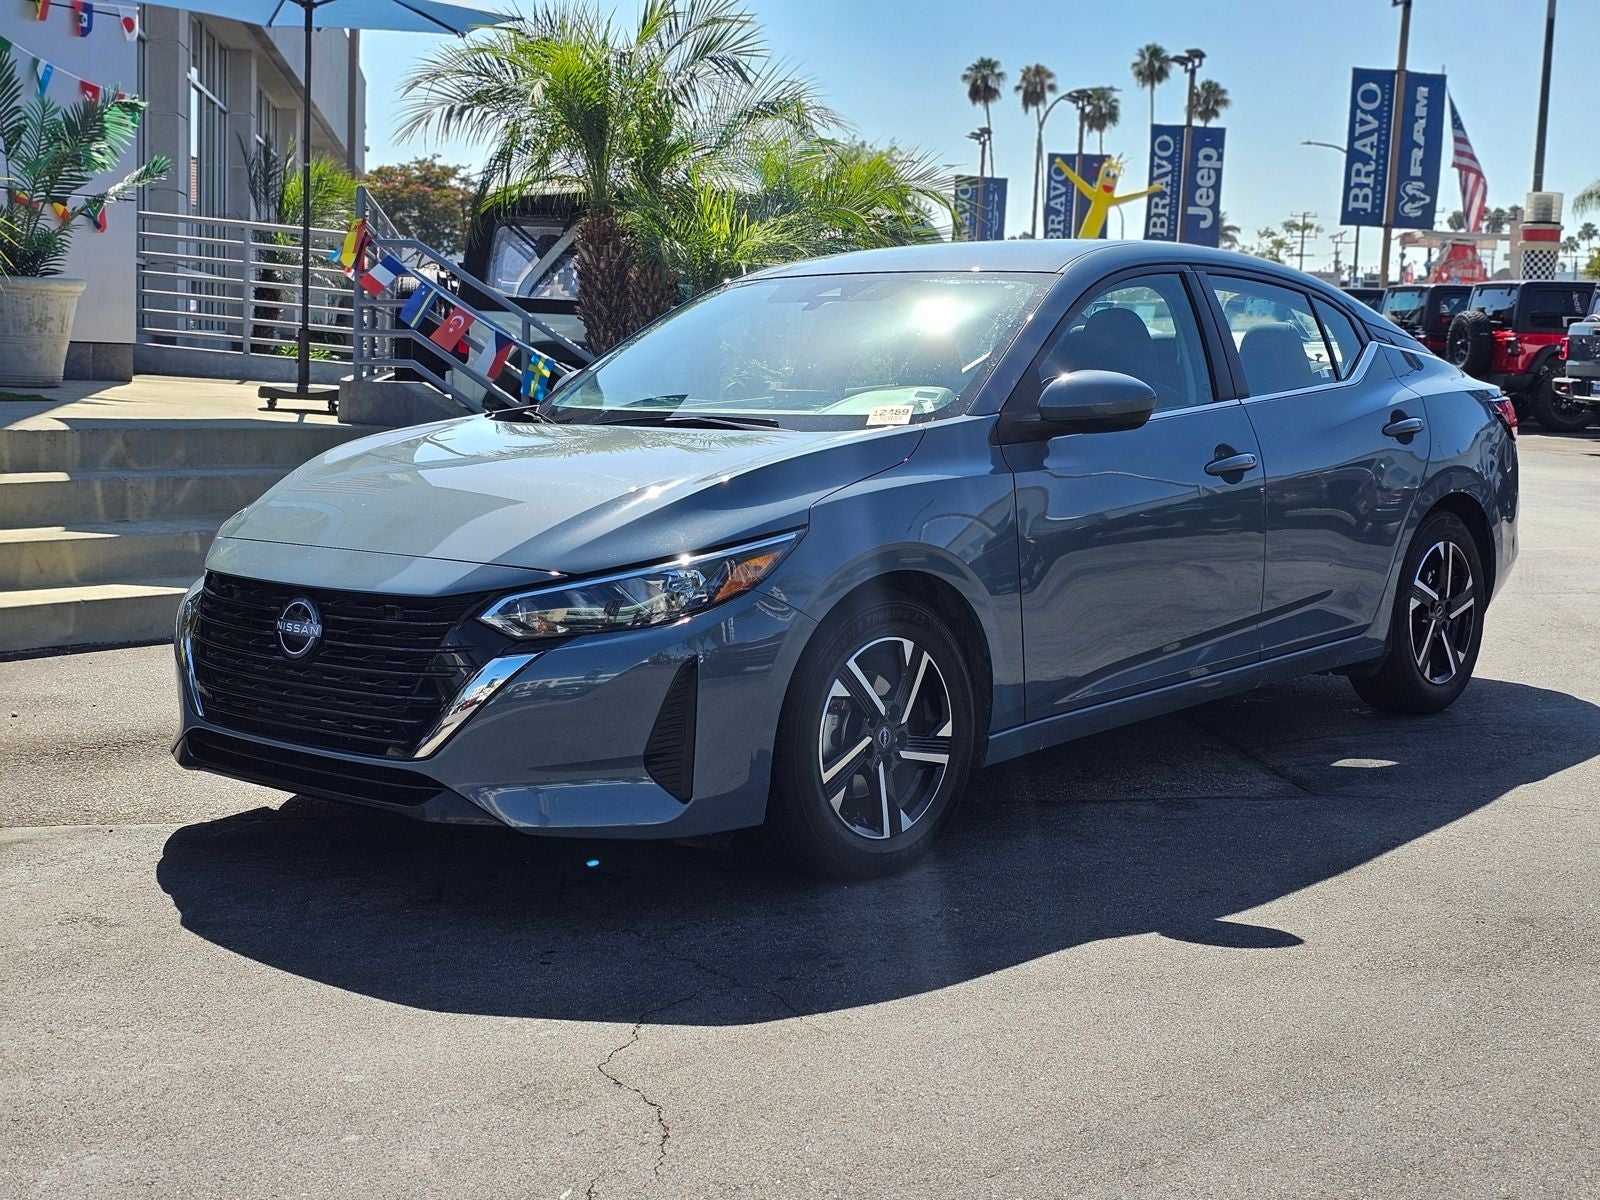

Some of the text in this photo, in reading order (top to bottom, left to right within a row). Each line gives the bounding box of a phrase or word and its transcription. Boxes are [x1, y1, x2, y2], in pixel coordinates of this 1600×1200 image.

[1348, 82, 1382, 213] BRAVO
[1409, 85, 1429, 177] RAM
[1148, 134, 1174, 236] BRAVO
[1186, 147, 1222, 229] Jeep
[276, 620, 319, 635] NISSAN
